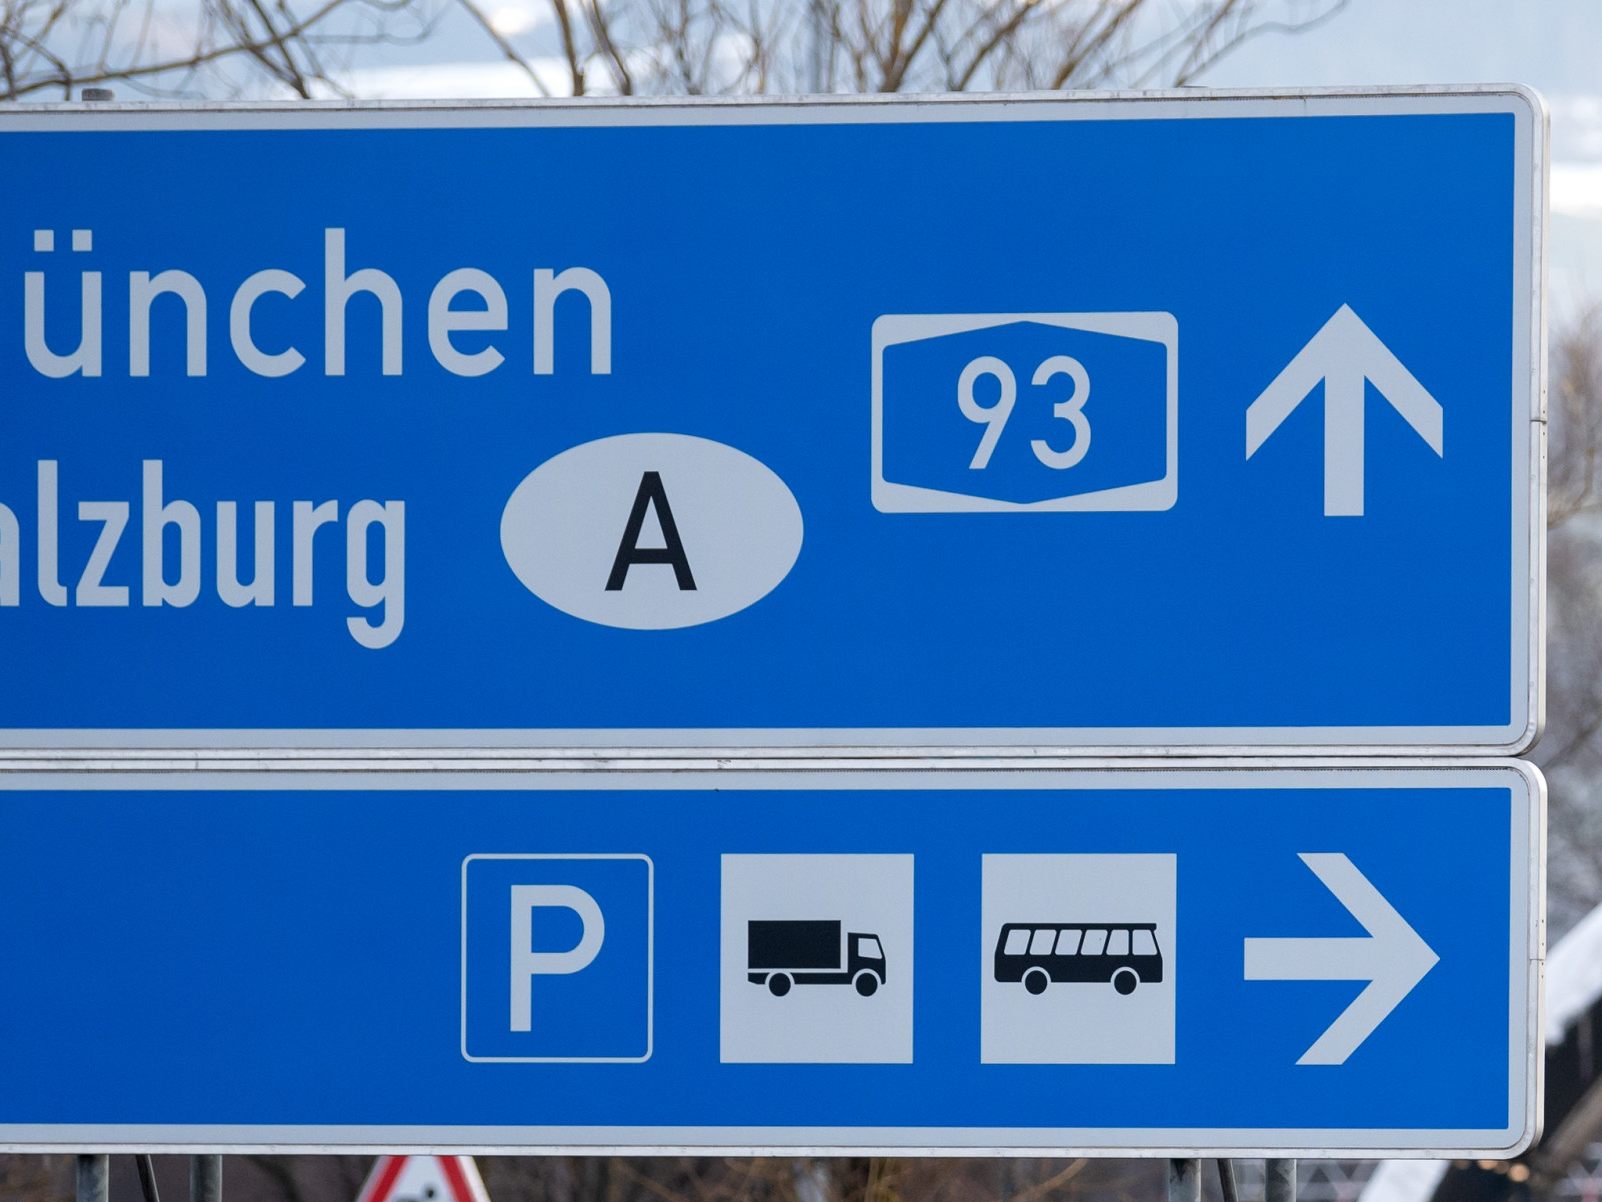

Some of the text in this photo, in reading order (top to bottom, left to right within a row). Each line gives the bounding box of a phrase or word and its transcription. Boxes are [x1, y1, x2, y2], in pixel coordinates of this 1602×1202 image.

[957, 355, 1092, 470] 93
[604, 471, 697, 592] A
[510, 884, 605, 1032] P
